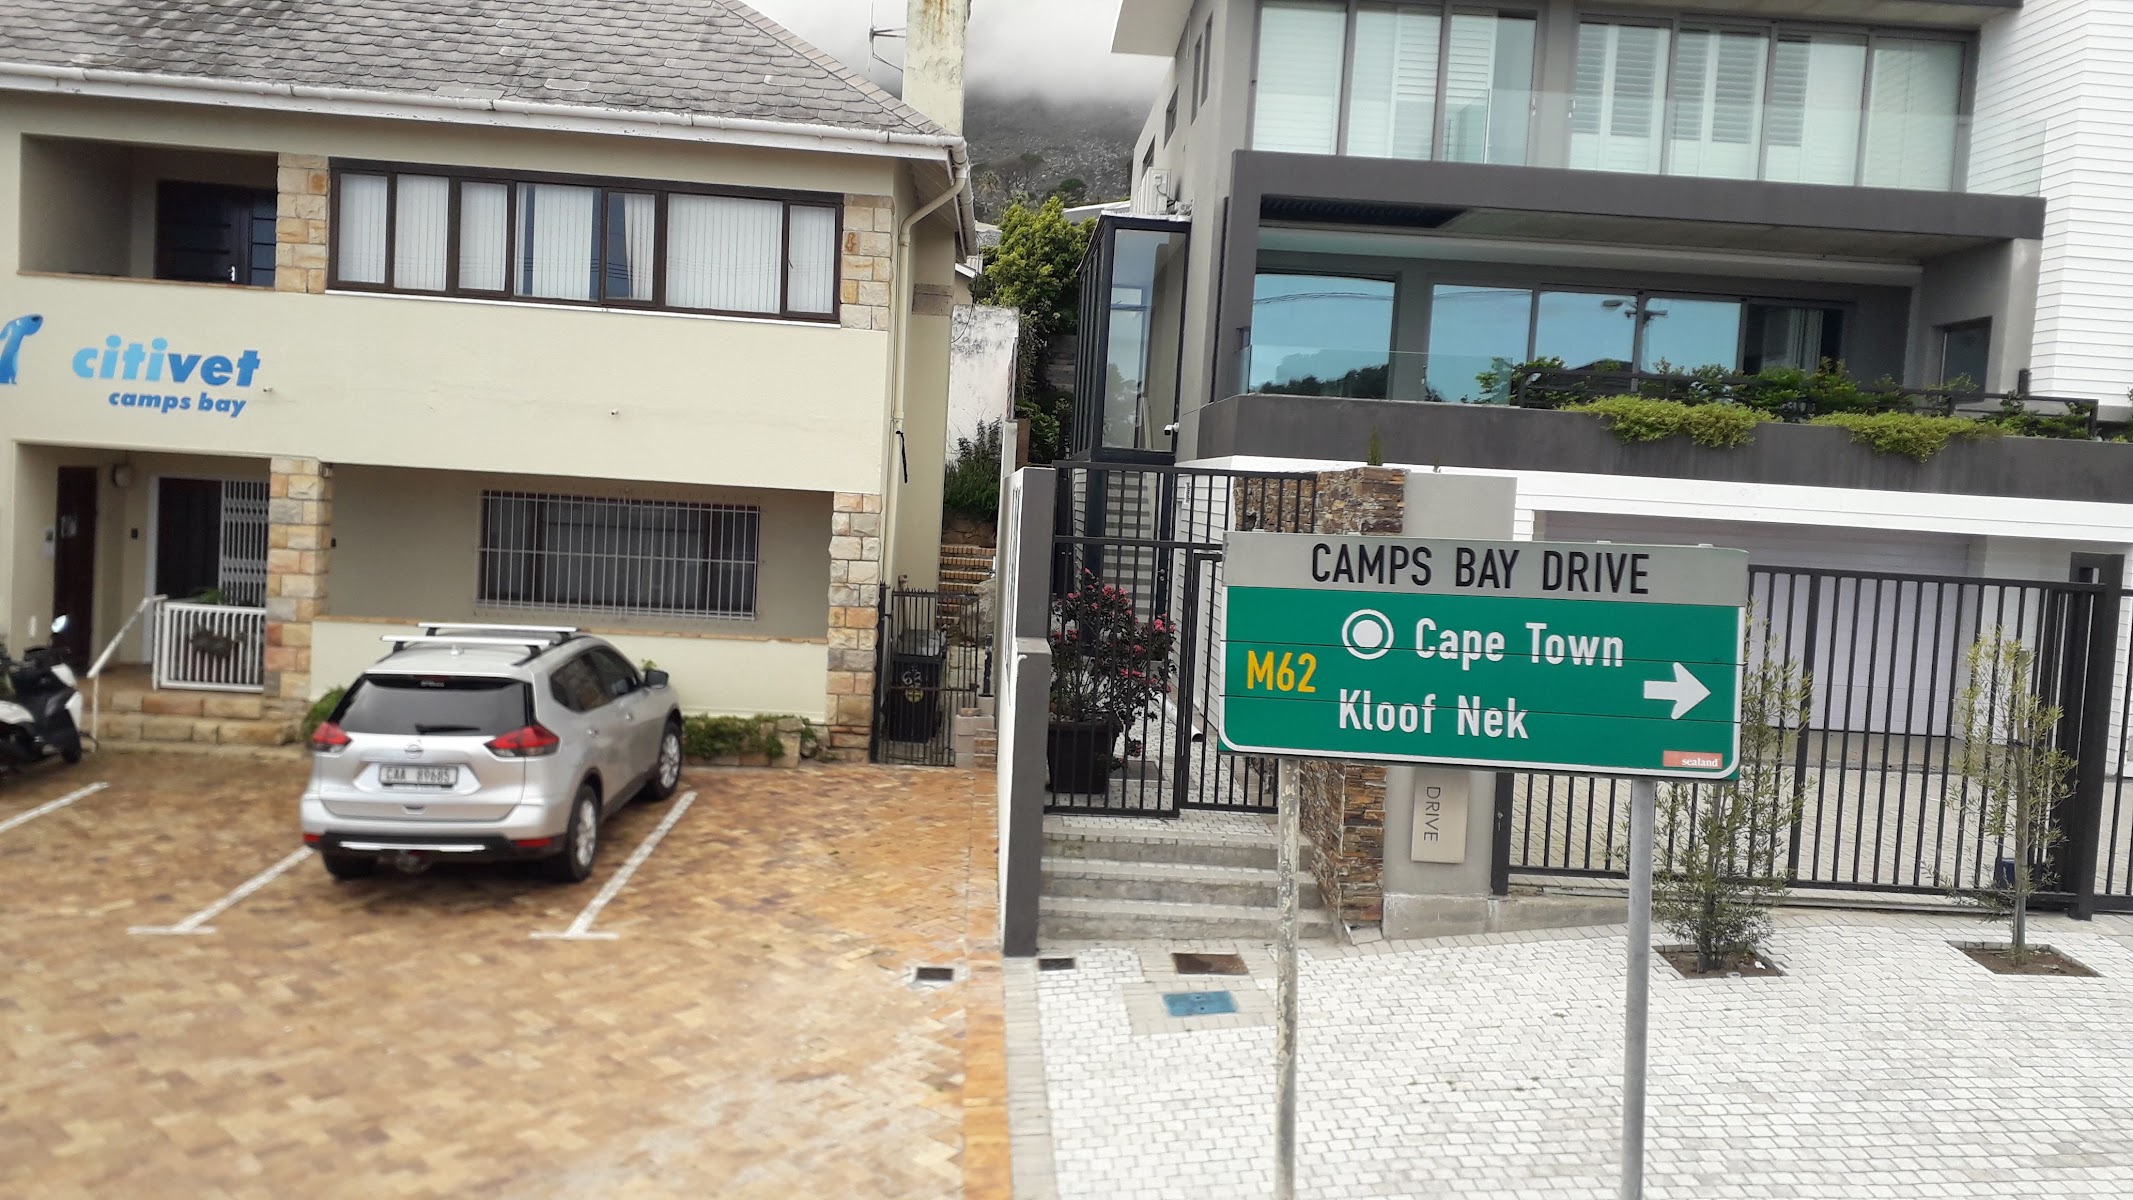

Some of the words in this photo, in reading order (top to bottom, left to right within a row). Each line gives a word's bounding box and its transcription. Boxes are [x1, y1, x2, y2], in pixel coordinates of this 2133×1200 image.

[72, 334, 260, 387] citivet
[108, 392, 190, 414] camps
[197, 392, 247, 418] bay
[1312, 543, 1432, 586] CAMPS
[1455, 547, 1520, 589] BAY
[1542, 550, 1649, 594] DRIVE
[1415, 617, 1505, 671] Cape
[1525, 622, 1624, 667] Town
[1246, 650, 1317, 693] M62
[1338, 688, 1437, 734] Kloof
[1457, 694, 1529, 739] Nek
[1681, 757, 1718, 767] sealand
[1423, 786, 1441, 842] DRIVE
